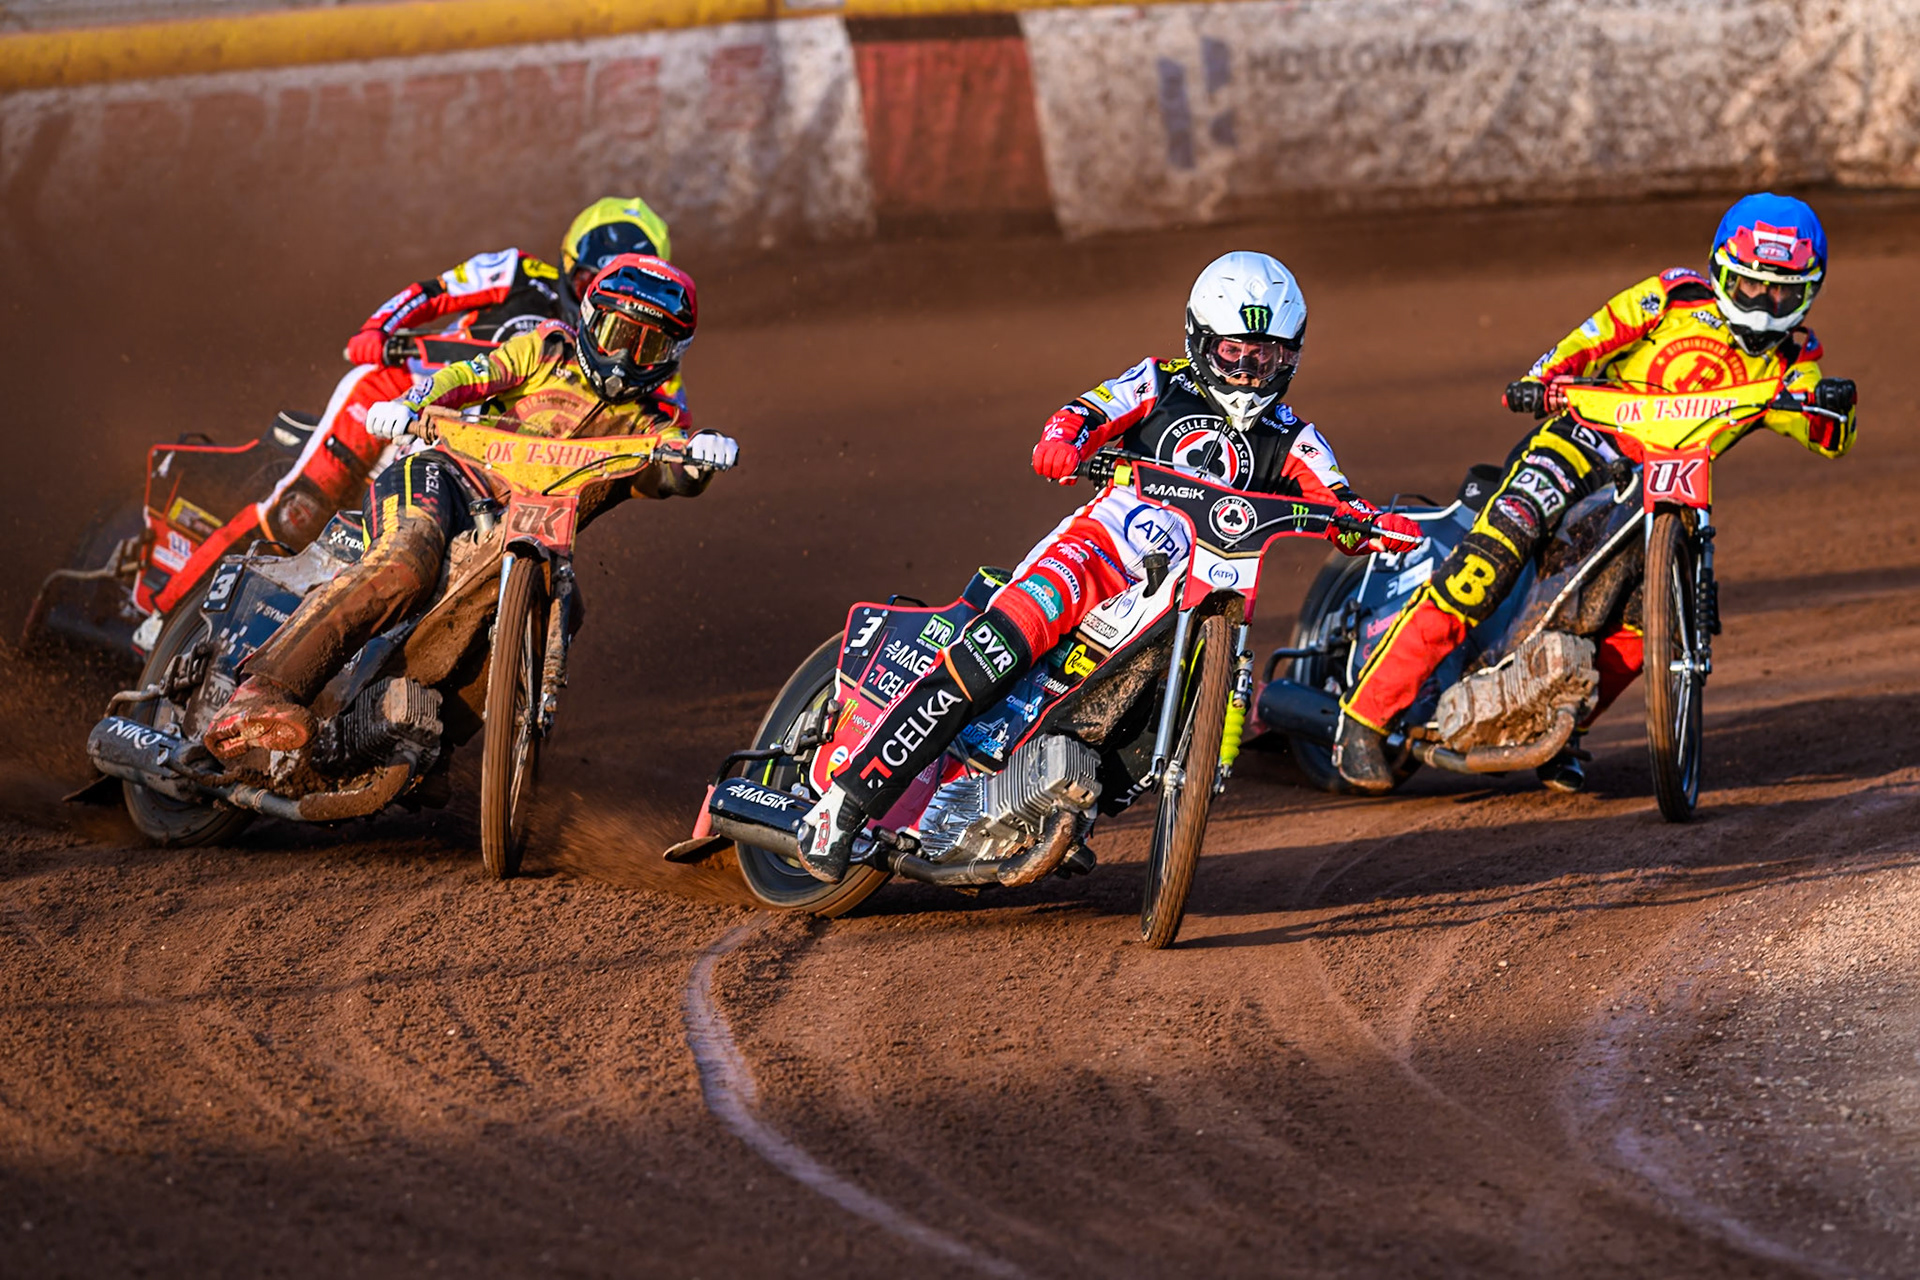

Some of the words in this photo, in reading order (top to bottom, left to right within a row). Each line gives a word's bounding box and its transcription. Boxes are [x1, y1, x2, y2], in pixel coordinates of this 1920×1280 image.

[632, 302, 664, 319] TEXOM
[1616, 401, 1645, 423] OK
[1655, 398, 1736, 419] T-SHIRT
[486, 441, 516, 463] OK
[526, 442, 613, 470] T-SHIRT
[1172, 419, 1208, 439] BELLE
[1213, 420, 1238, 440] VUE
[1235, 443, 1250, 475] ACES
[1516, 472, 1560, 513] DVR
[344, 537, 367, 552] TEX
[1134, 520, 1180, 561] ATPI
[209, 572, 237, 601] 3
[1050, 559, 1081, 600] PRONAR
[1213, 569, 1235, 580] ATPI
[1445, 553, 1496, 606] B
[850, 616, 883, 648] 3
[923, 619, 951, 645] DVR
[891, 644, 936, 677] MAG
[971, 624, 1013, 673] DVR
[972, 650, 998, 683] INDUSTRIES
[877, 671, 911, 699] CEL
[881, 689, 964, 767] CELKA
